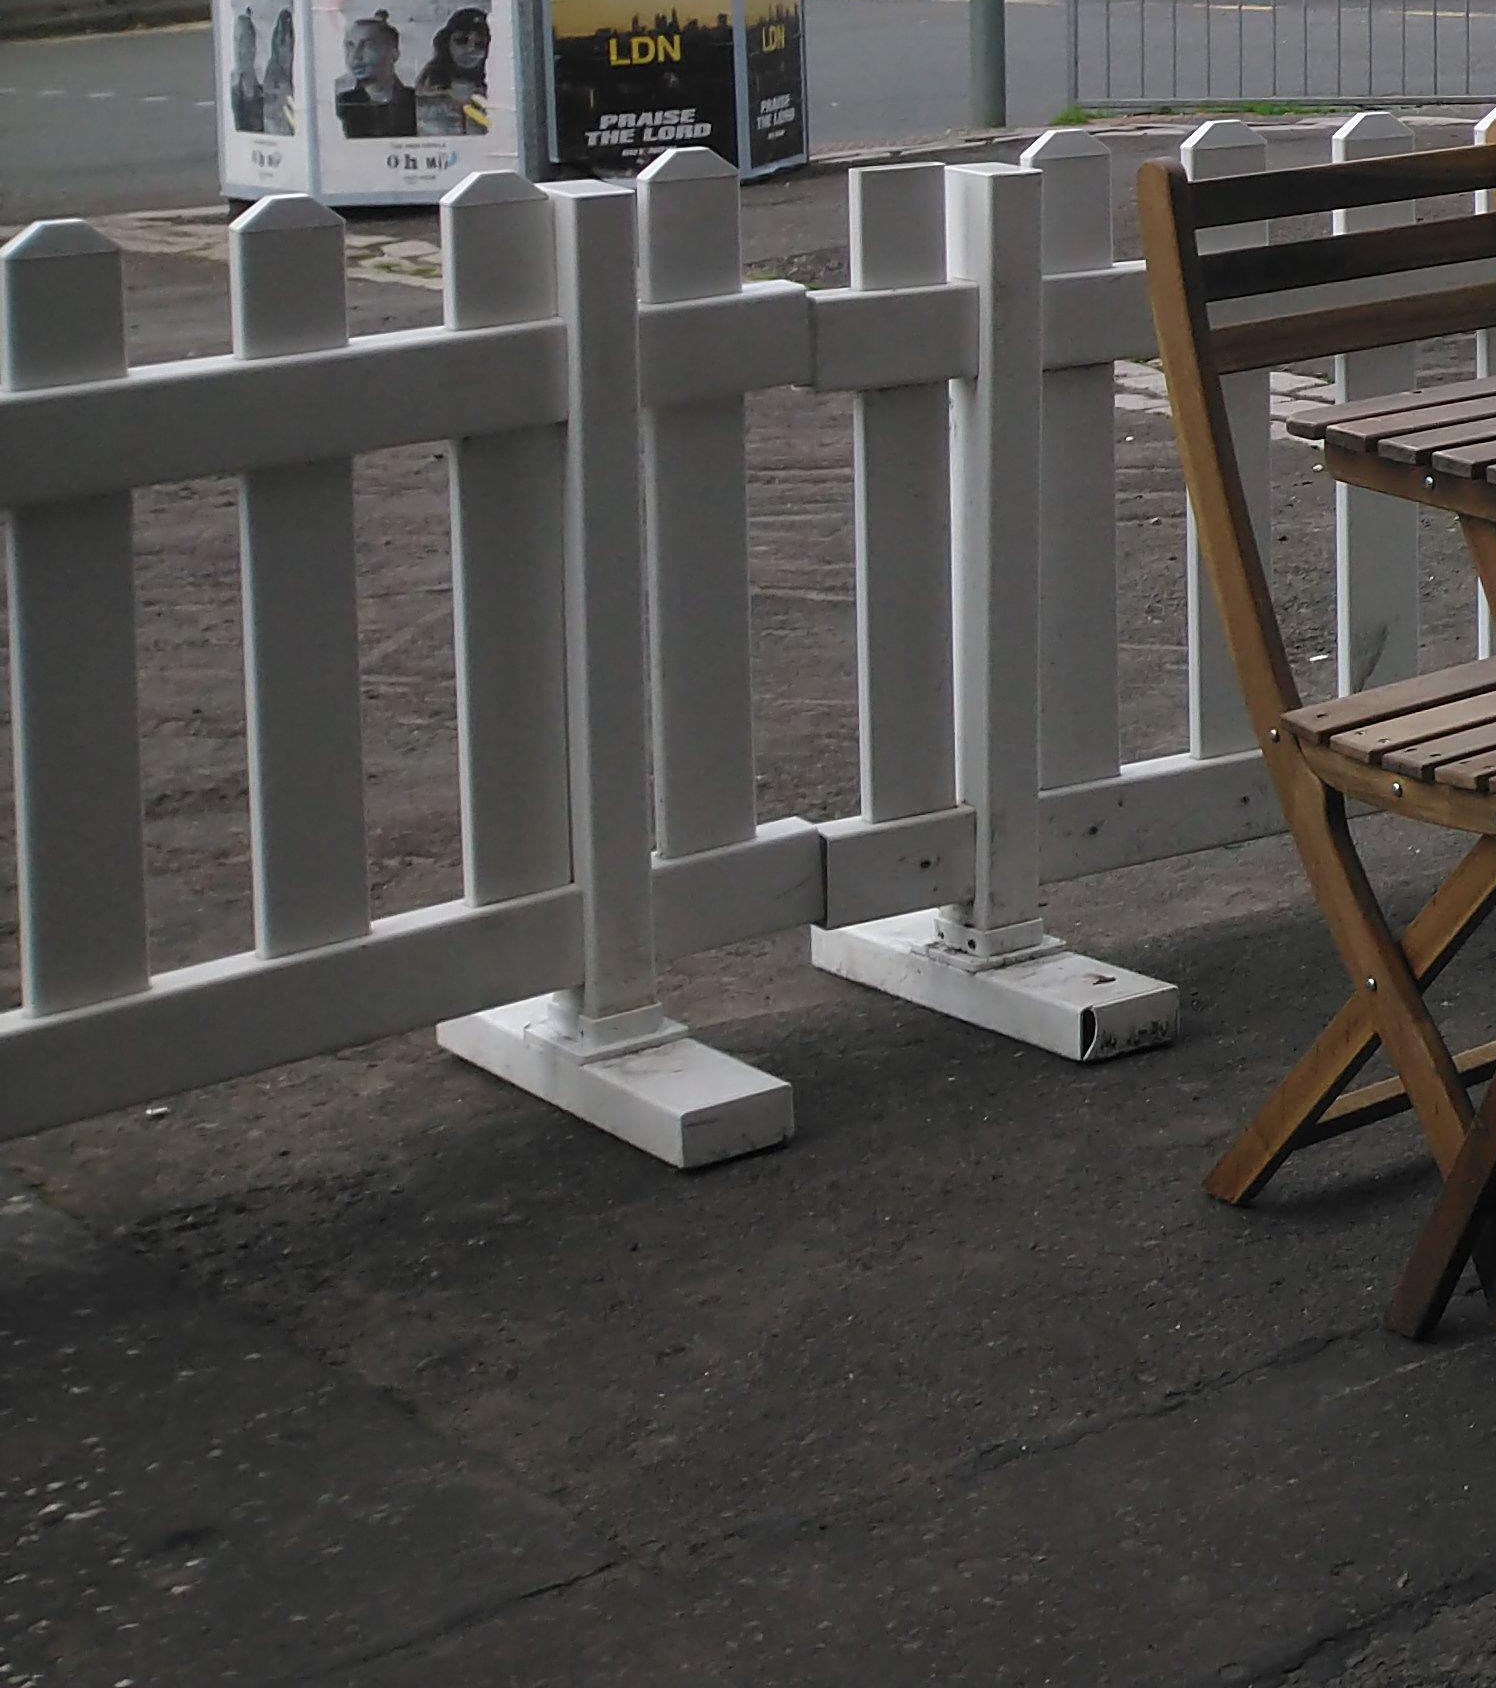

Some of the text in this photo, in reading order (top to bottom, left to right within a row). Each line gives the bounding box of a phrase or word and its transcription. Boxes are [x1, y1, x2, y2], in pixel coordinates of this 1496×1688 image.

[609, 34, 681, 66] LDN
[599, 108, 696, 129] PRAISE
[585, 123, 712, 146] THE LORD
